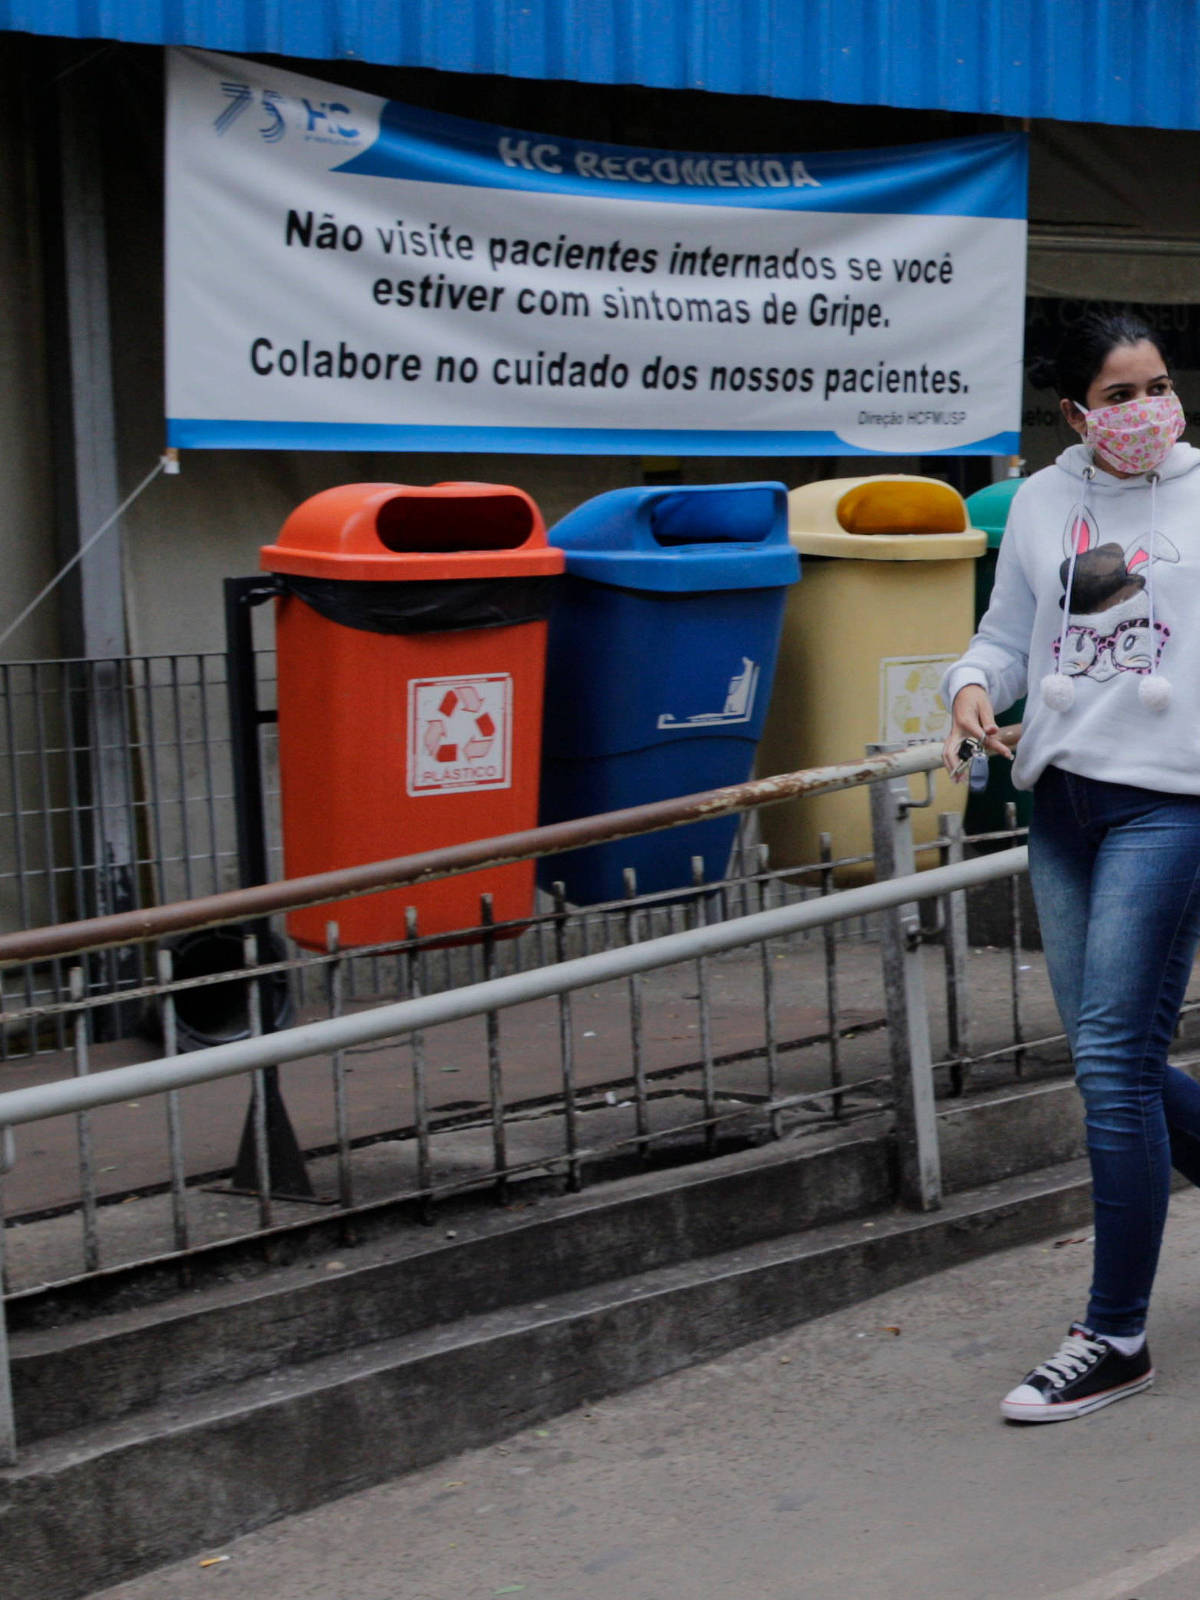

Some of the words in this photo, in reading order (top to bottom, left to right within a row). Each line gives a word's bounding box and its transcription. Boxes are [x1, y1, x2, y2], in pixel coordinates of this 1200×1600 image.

[214, 82, 286, 144] 75
[499, 136, 562, 174] HC
[574, 150, 822, 188] RECOMENDA
[285, 209, 364, 253] Não
[376, 219, 474, 261] visite
[489, 234, 658, 275] pacientes
[669, 242, 837, 281] internados
[848, 257, 882, 282] se
[894, 252, 953, 285] você
[373, 273, 505, 313] estiver
[516, 287, 590, 318] com
[603, 286, 751, 325] sintomas
[763, 292, 798, 326] de
[809, 292, 890, 336] Gripe.
[250, 337, 422, 382] Colabore
[436, 355, 479, 384] no
[493, 350, 630, 389] cuidado
[642, 356, 699, 391] dos
[710, 366, 814, 393] nossos
[824, 360, 969, 401] pacientes.
[858, 410, 903, 428] Direção
[907, 410, 967, 425] HCFMUSP
